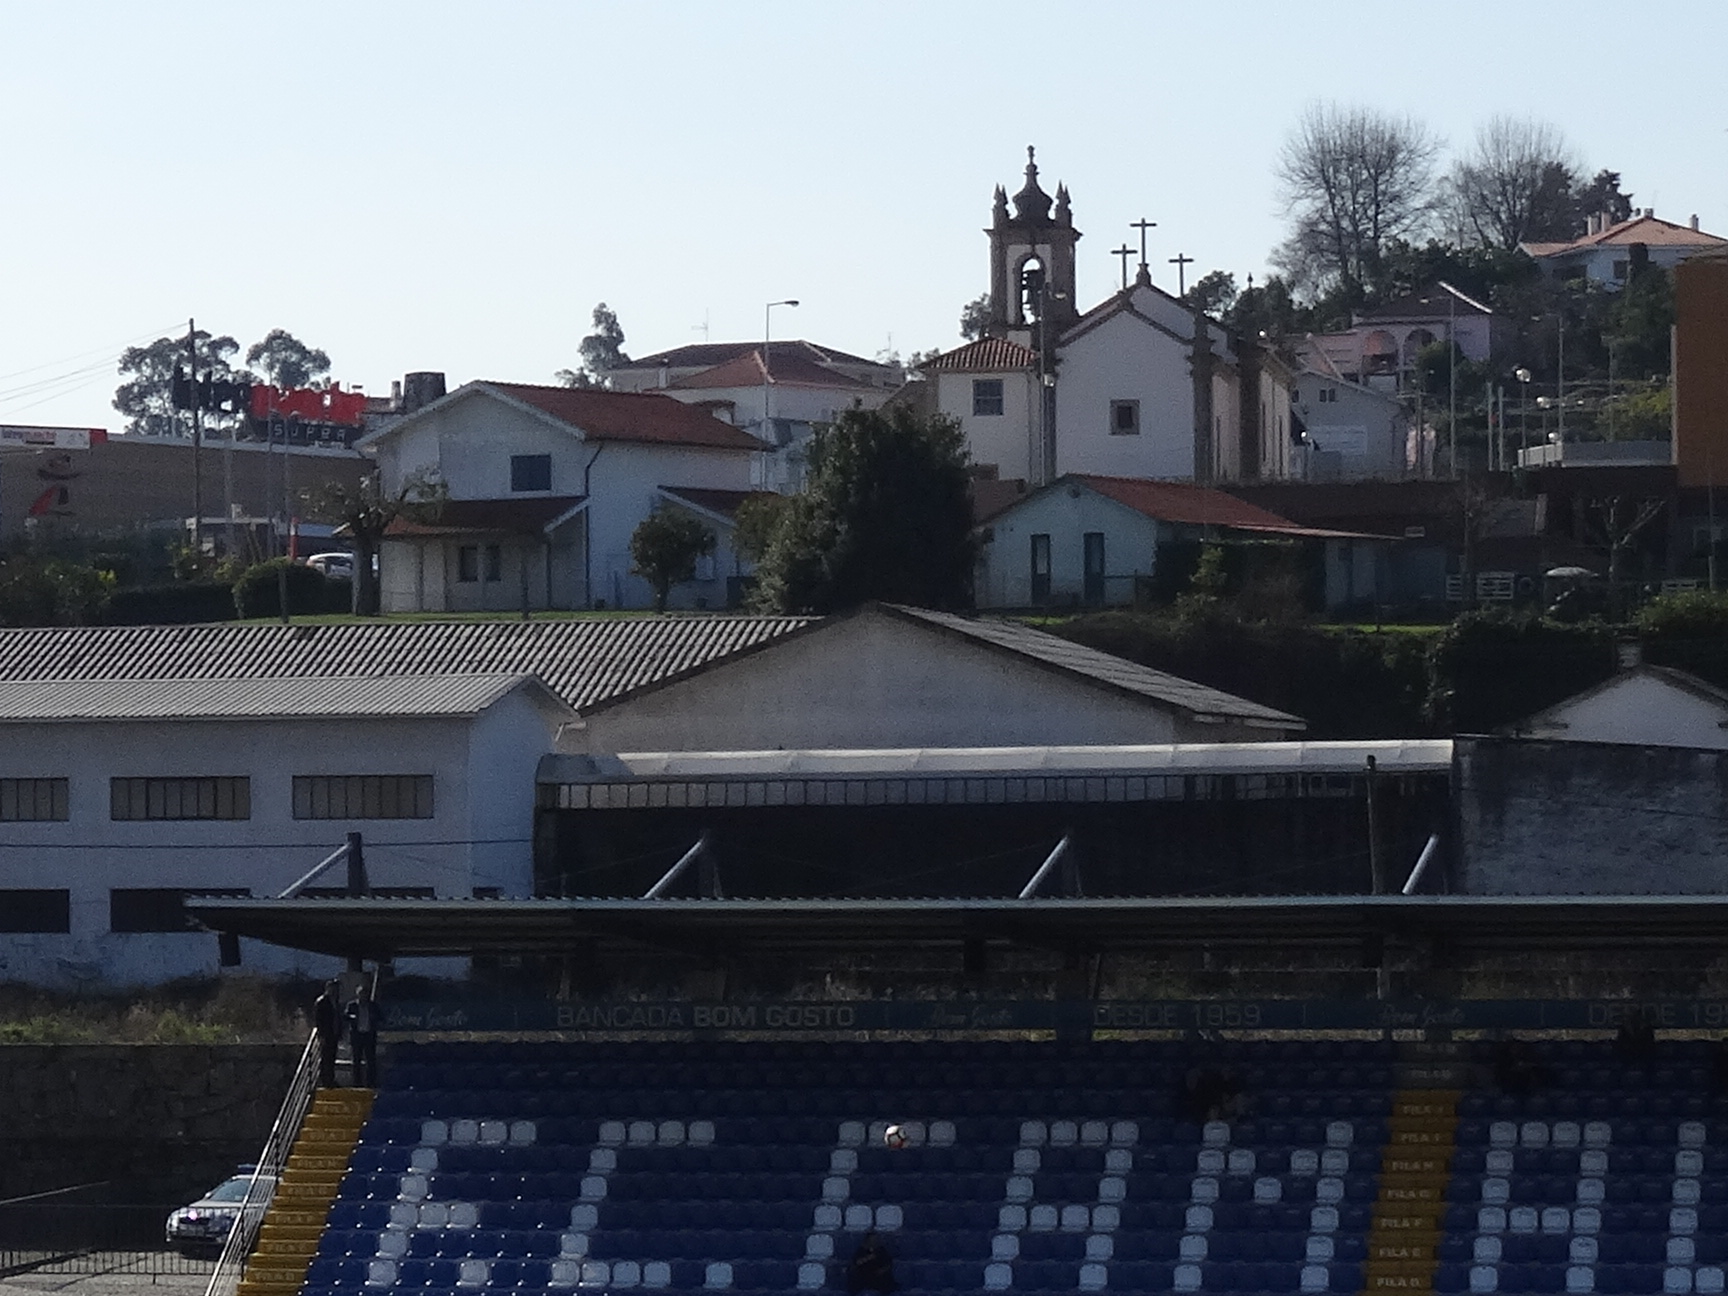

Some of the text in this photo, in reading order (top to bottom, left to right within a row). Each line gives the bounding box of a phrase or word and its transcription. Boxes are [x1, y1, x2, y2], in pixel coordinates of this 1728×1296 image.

[557, 1005, 855, 1027] BANCADA BOM GOSTO
[1195, 1005, 1263, 1026] 1959
